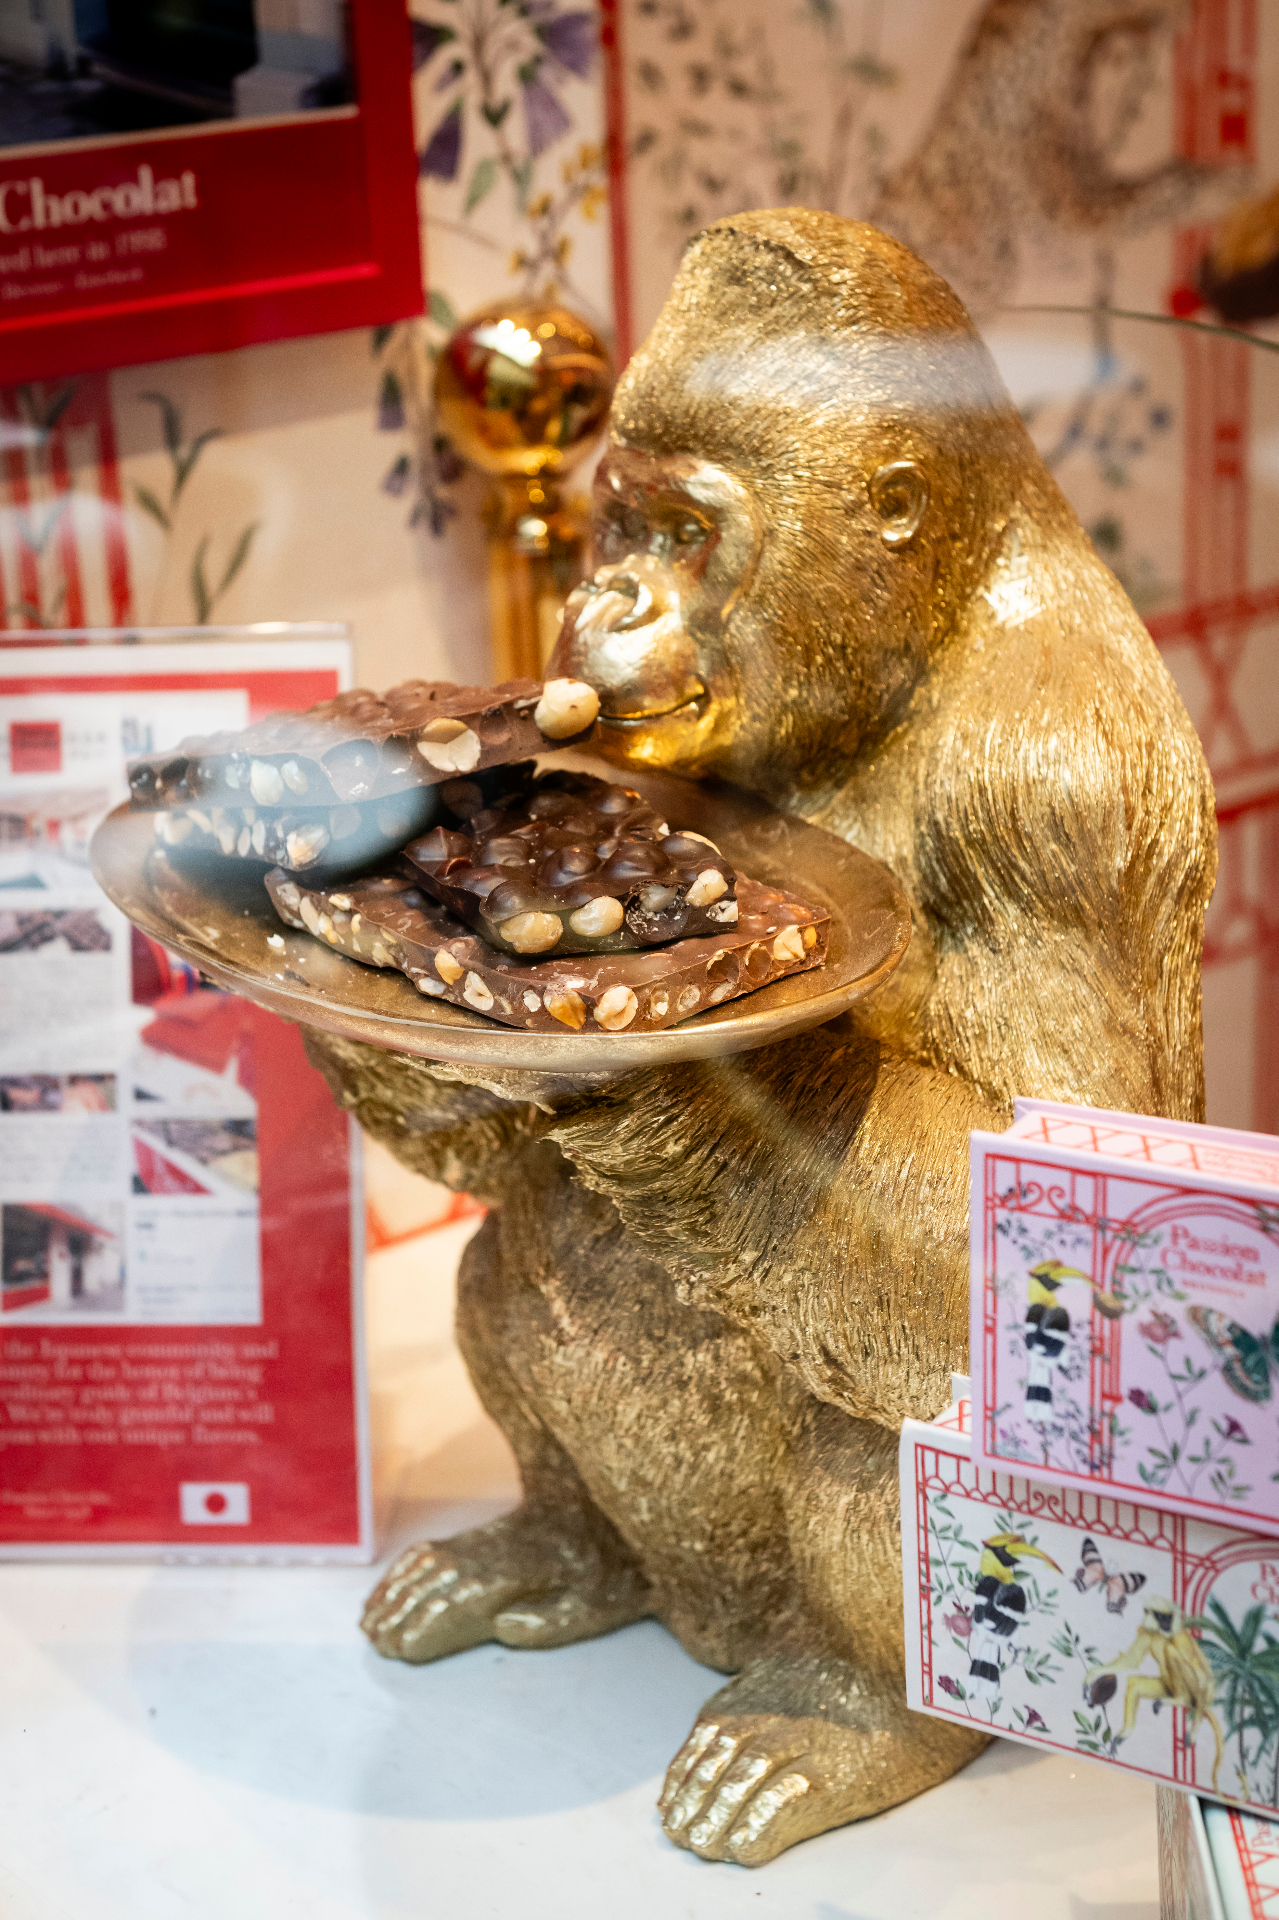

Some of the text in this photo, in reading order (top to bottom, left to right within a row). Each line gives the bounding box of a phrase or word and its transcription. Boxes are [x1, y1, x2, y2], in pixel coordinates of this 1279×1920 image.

[0, 163, 198, 234] Chocolat
[1170, 1224, 1260, 1264] Passion
[1160, 1246, 1267, 1288] Chocolat
